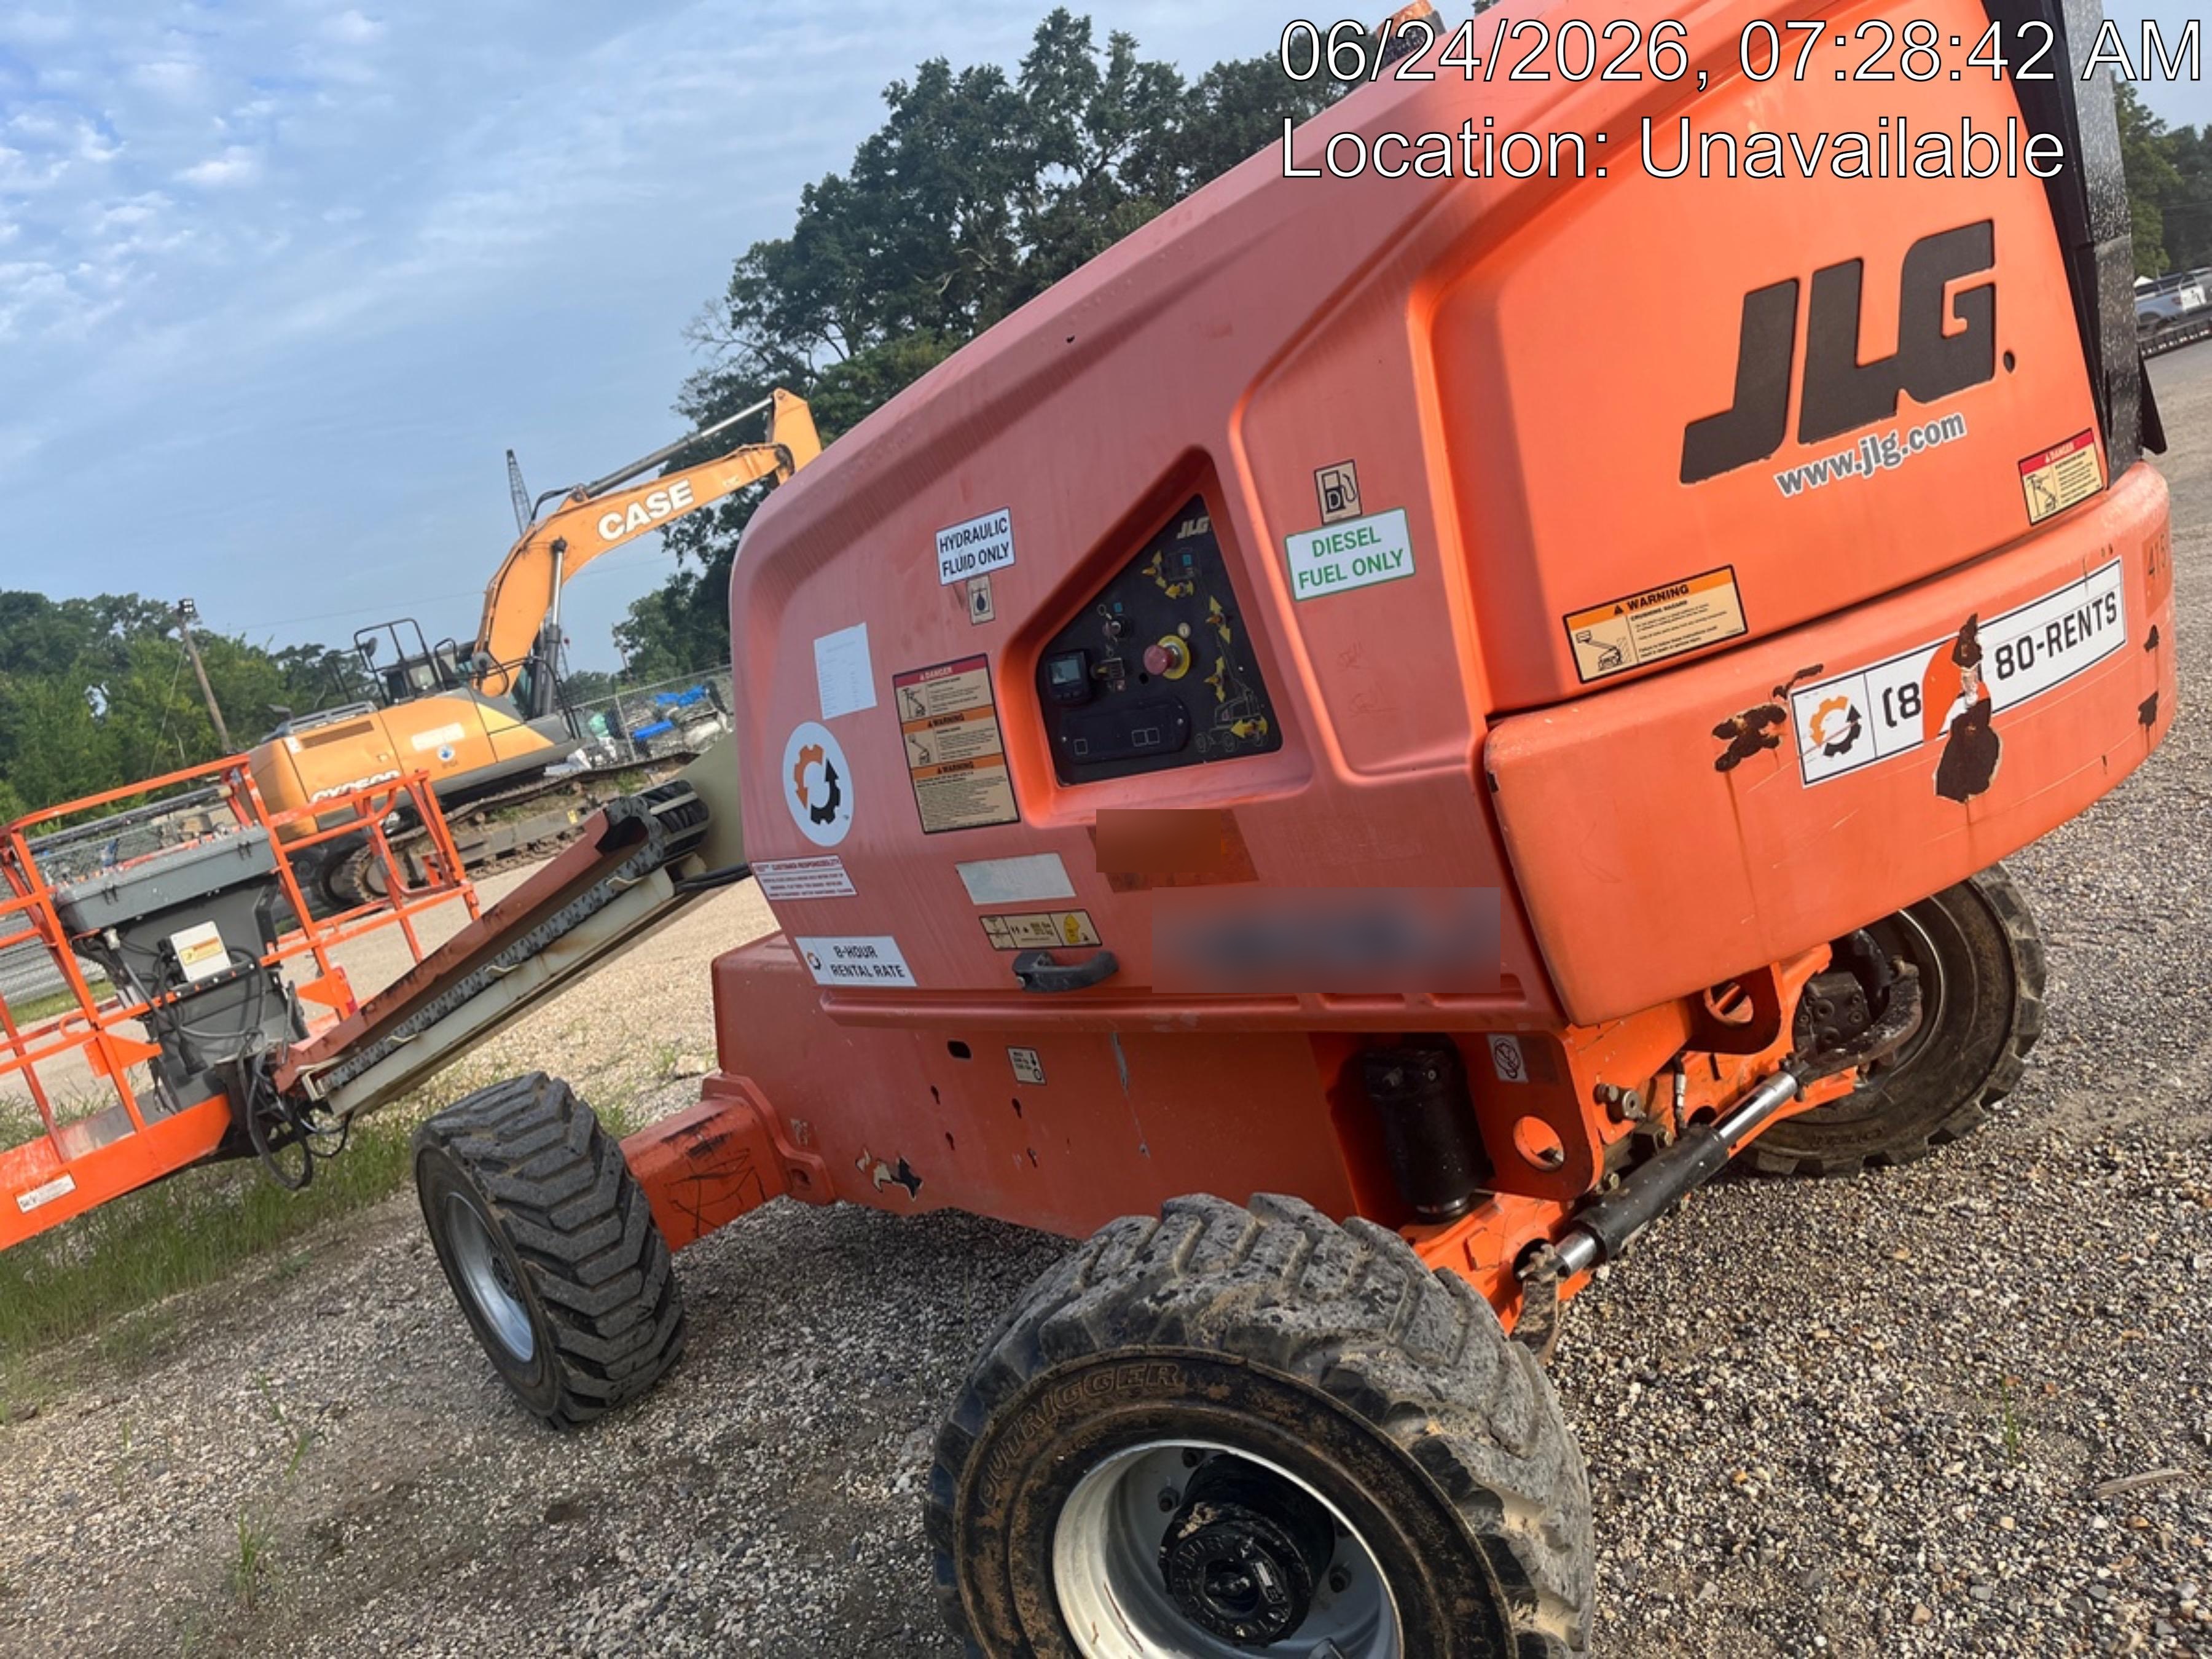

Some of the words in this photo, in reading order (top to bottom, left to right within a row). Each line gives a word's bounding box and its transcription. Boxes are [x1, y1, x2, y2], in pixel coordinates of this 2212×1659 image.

[1680, 219, 1995, 484] JLG
[1776, 412, 1966, 495] www.jlg.com
[598, 479, 695, 541] CASE
[1177, 517, 1209, 539] JLG
[939, 517, 1008, 553] HYDRAULIC
[1312, 525, 1381, 558] DIESEL
[942, 553, 975, 576] FLUID
[978, 541, 1009, 565] ONLY
[1298, 563, 1347, 590] FUEL
[1352, 548, 1403, 576] ONLY
[1627, 584, 1689, 611] WARNING
[1996, 592, 2117, 681] 80-RENTS
[831, 963, 874, 978] RENTAL
[873, 965, 906, 978] RATE
